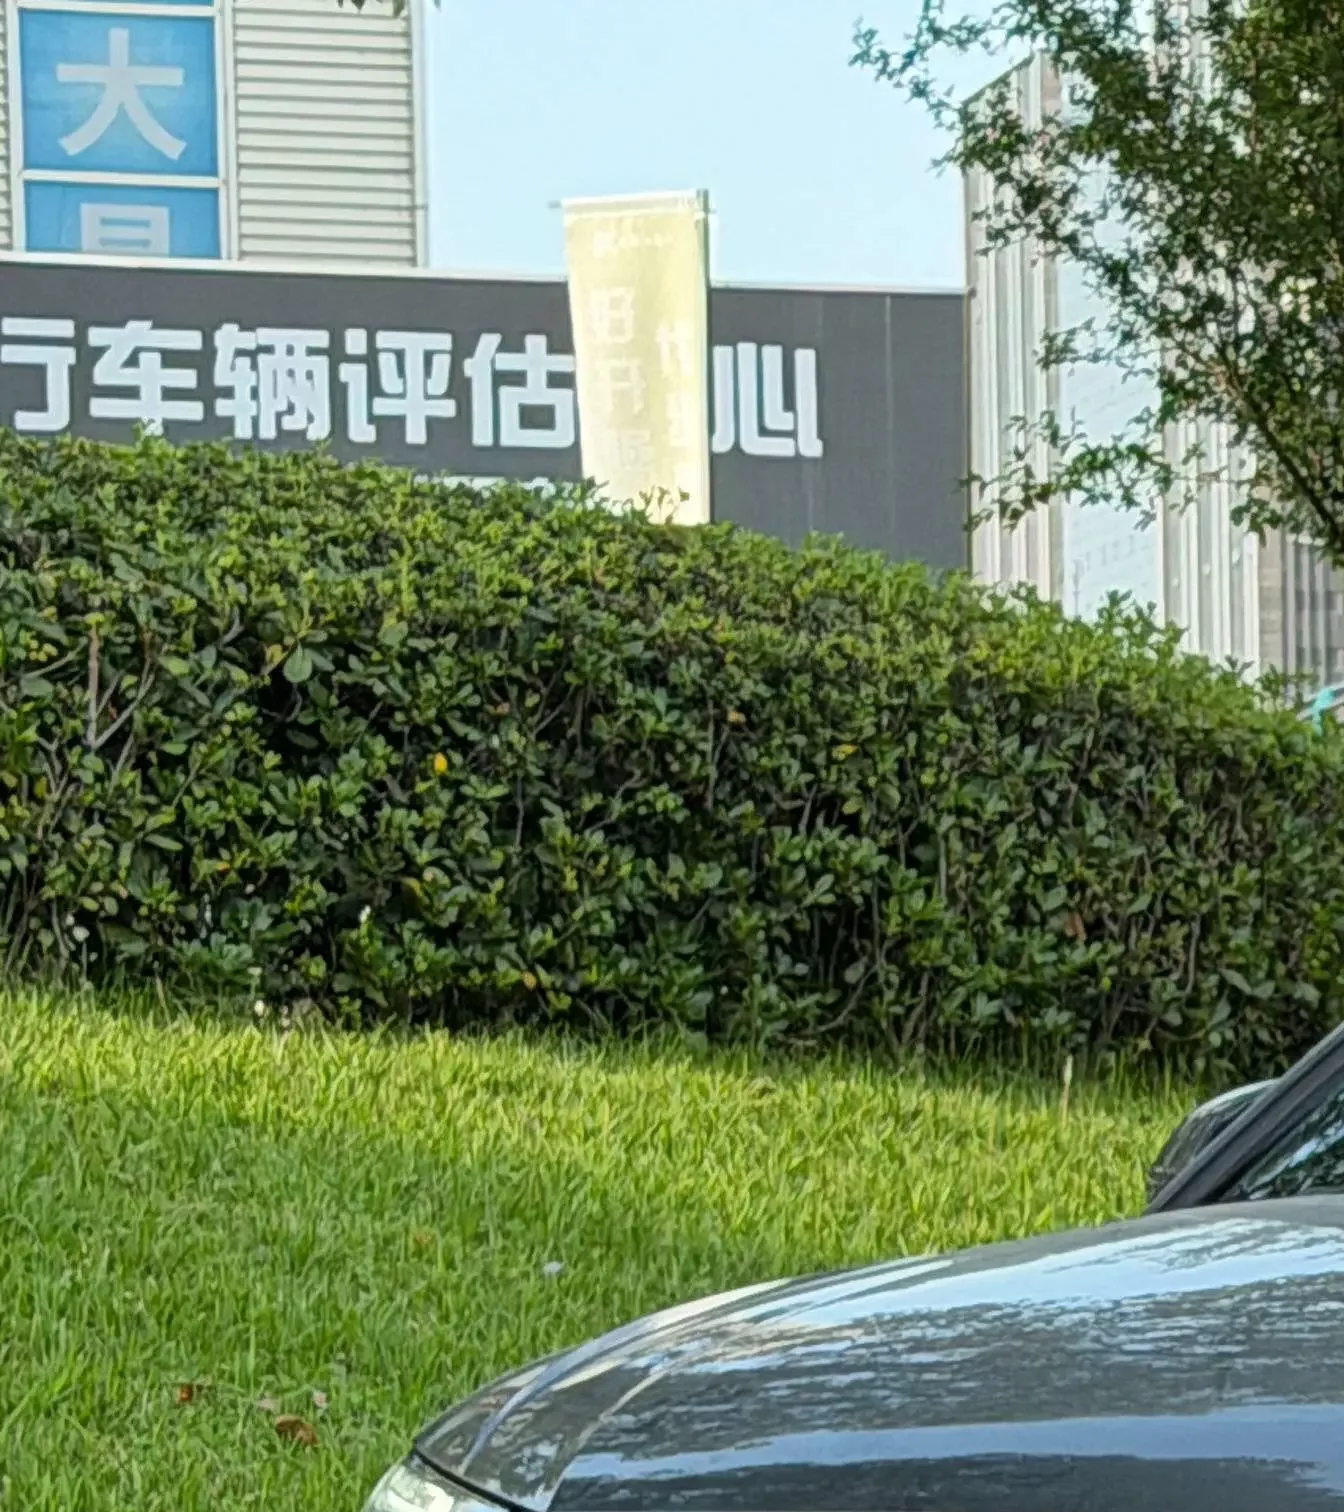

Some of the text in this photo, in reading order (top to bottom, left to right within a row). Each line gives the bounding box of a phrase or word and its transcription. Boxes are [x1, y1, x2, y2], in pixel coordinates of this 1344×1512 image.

[0, 316, 823, 459] 行车辆评估心
